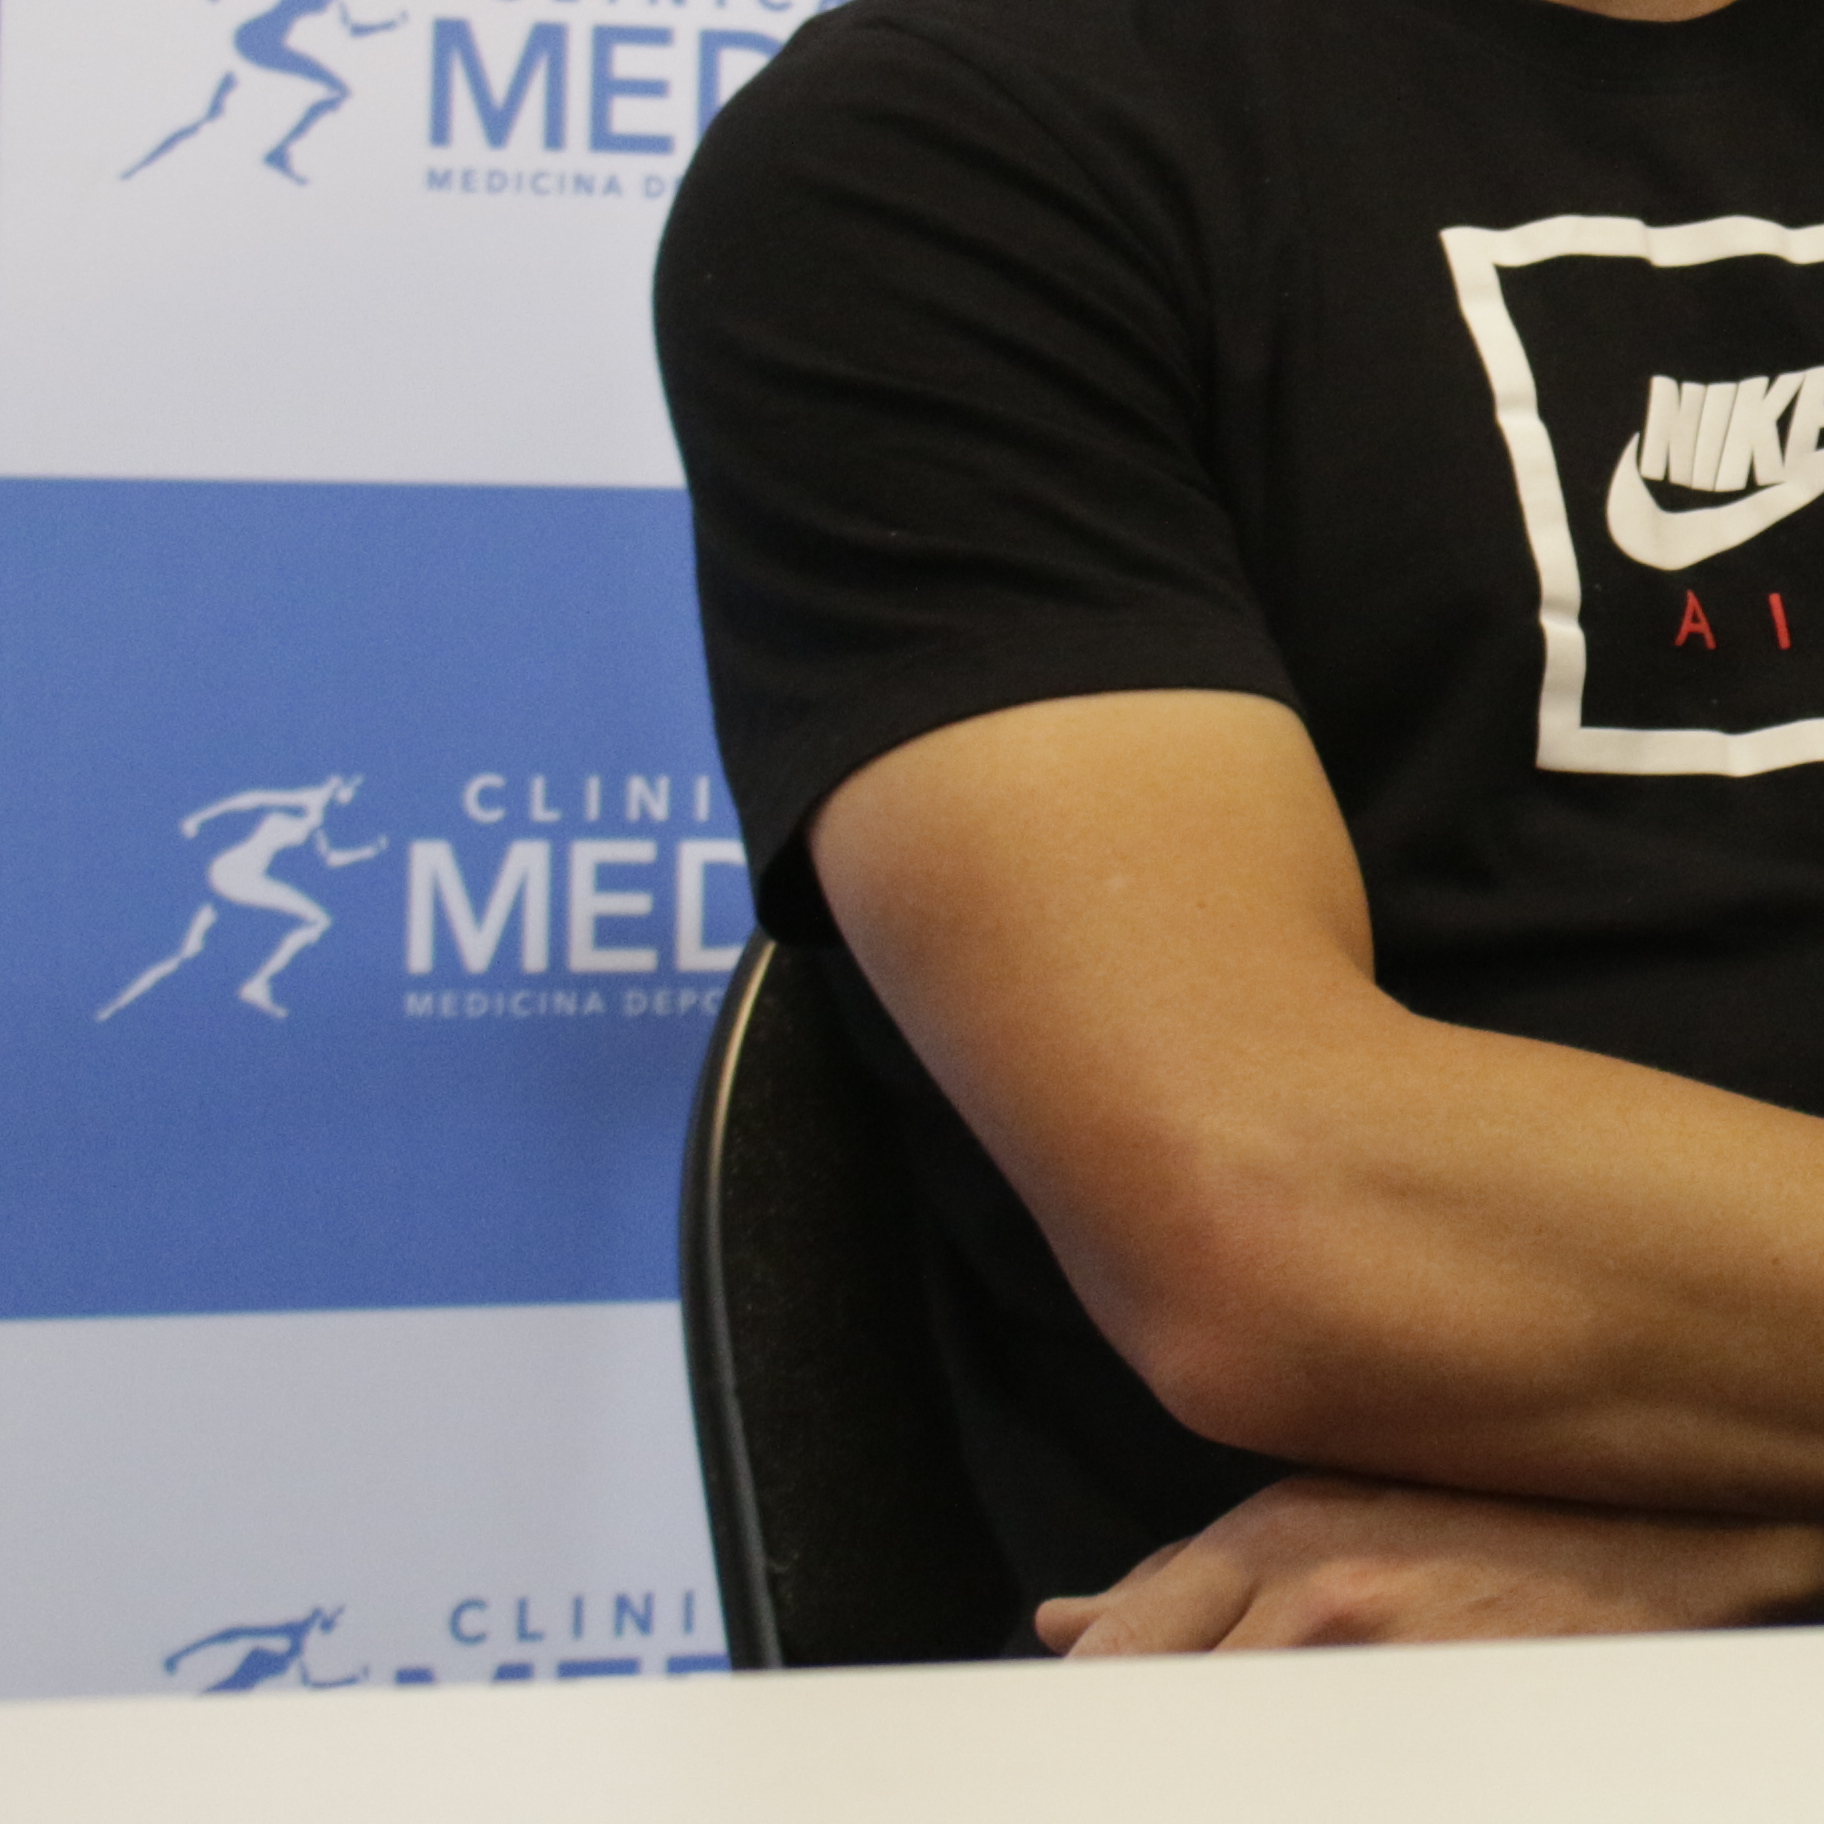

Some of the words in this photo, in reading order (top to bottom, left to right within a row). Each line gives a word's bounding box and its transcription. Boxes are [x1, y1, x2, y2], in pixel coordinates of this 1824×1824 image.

[426, 169, 620, 195] MEDICINA
[464, 774, 709, 823] CLINI
[405, 838, 745, 974] MED
[404, 991, 602, 1017] MEDICINA
[448, 1590, 695, 1645] CLINI
